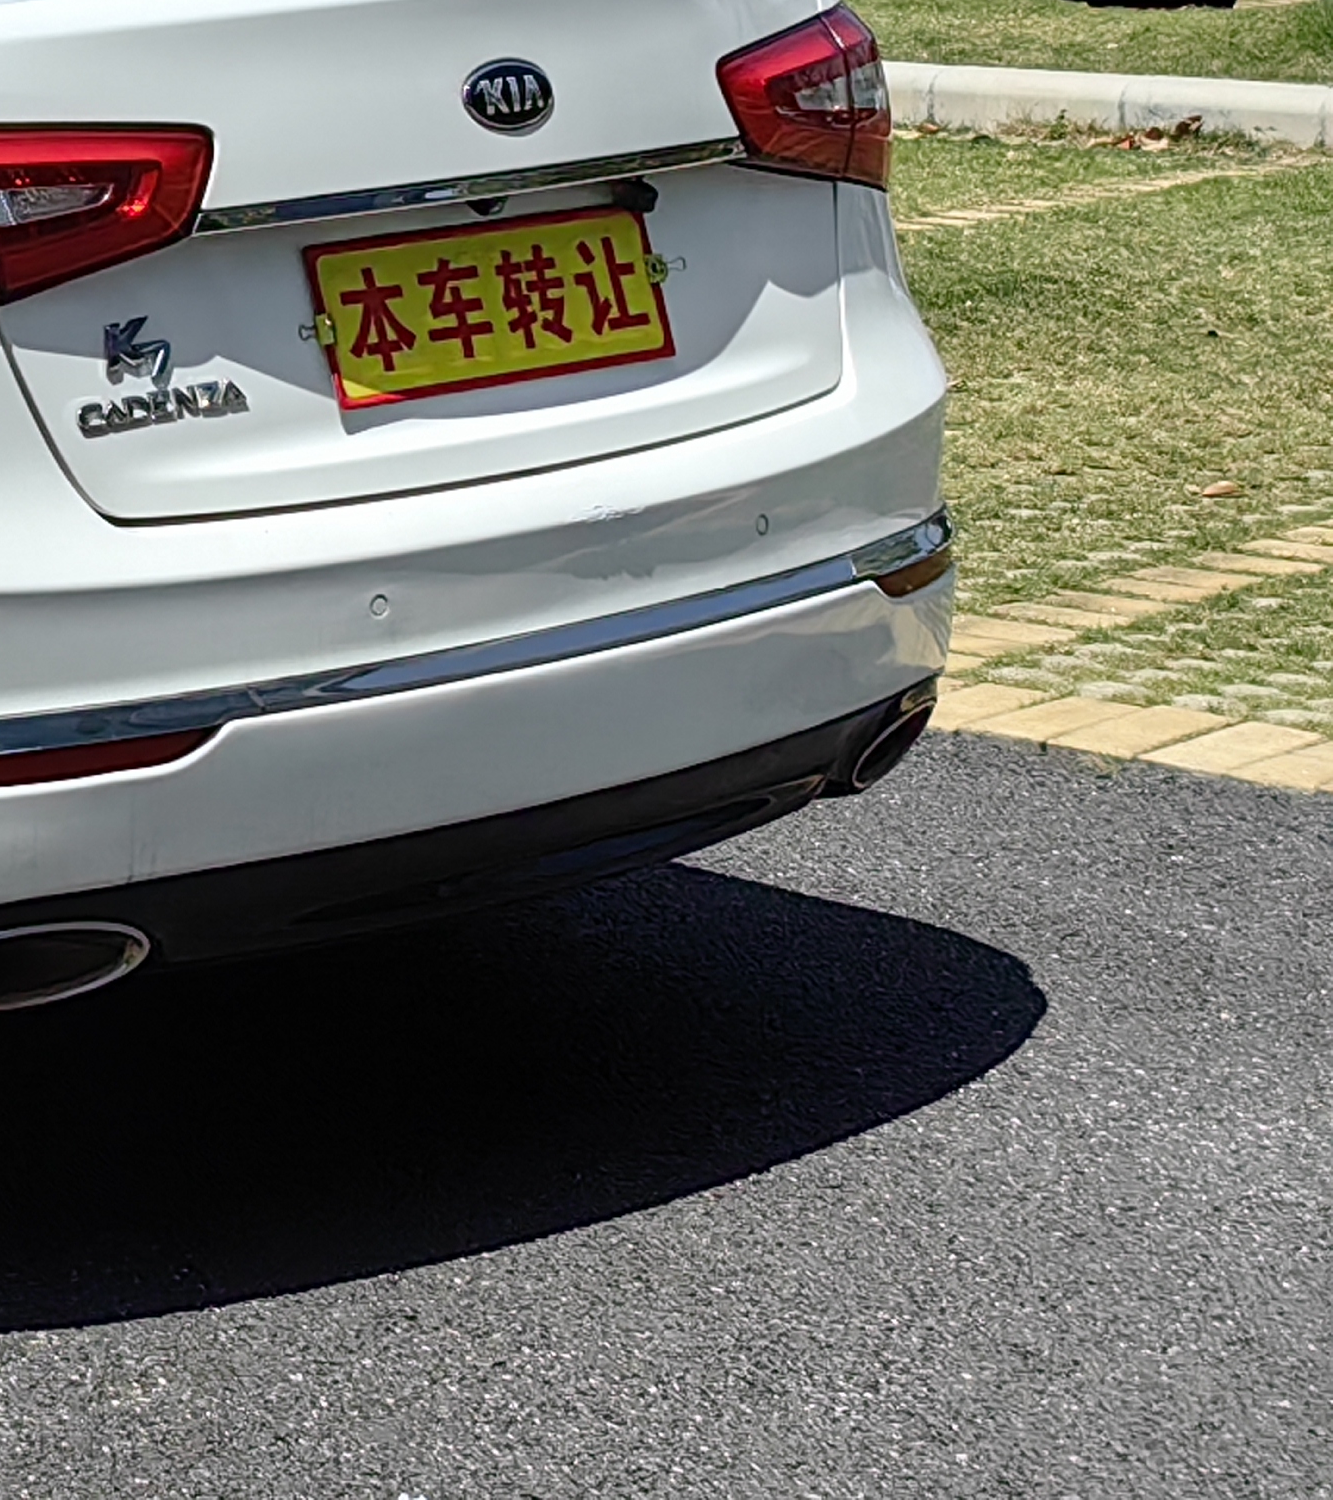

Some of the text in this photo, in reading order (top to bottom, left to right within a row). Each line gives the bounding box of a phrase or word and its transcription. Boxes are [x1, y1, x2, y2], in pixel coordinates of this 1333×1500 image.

[473, 74, 544, 116] KIA
[339, 235, 651, 373] 本车转让
[103, 315, 174, 388] K7
[77, 378, 250, 439] CADENZA
